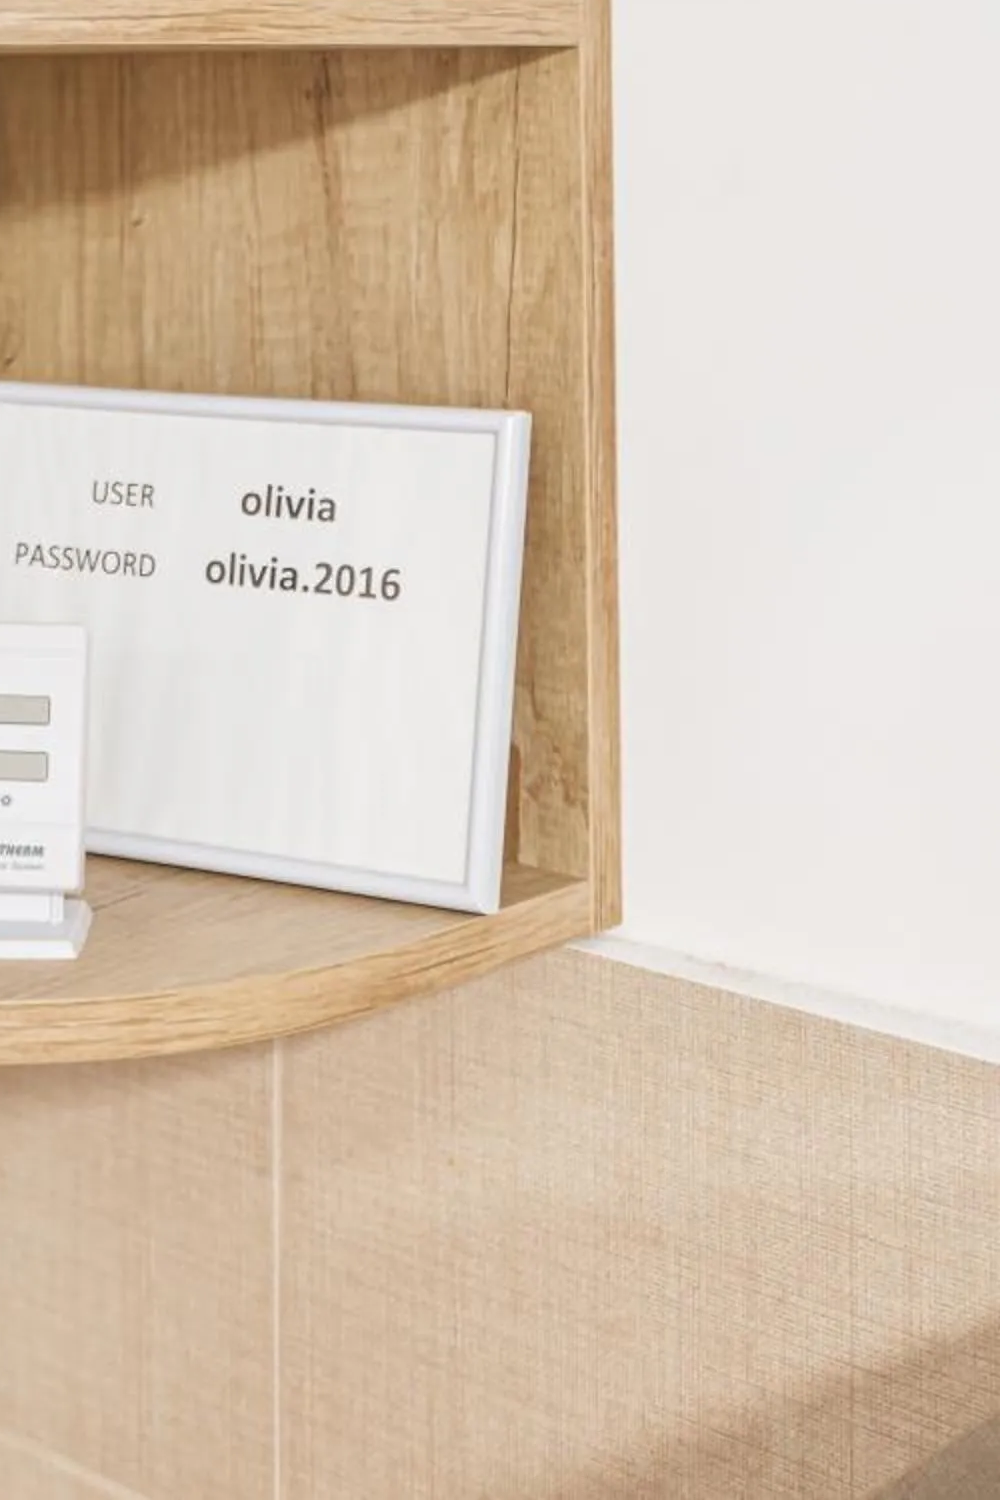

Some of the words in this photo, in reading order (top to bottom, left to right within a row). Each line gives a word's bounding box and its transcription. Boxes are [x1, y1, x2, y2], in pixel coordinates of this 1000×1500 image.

[92, 480, 155, 508] USER
[241, 484, 337, 523] olivia
[14, 542, 157, 579] PASSWORD
[205, 552, 402, 602] olivia.2016
